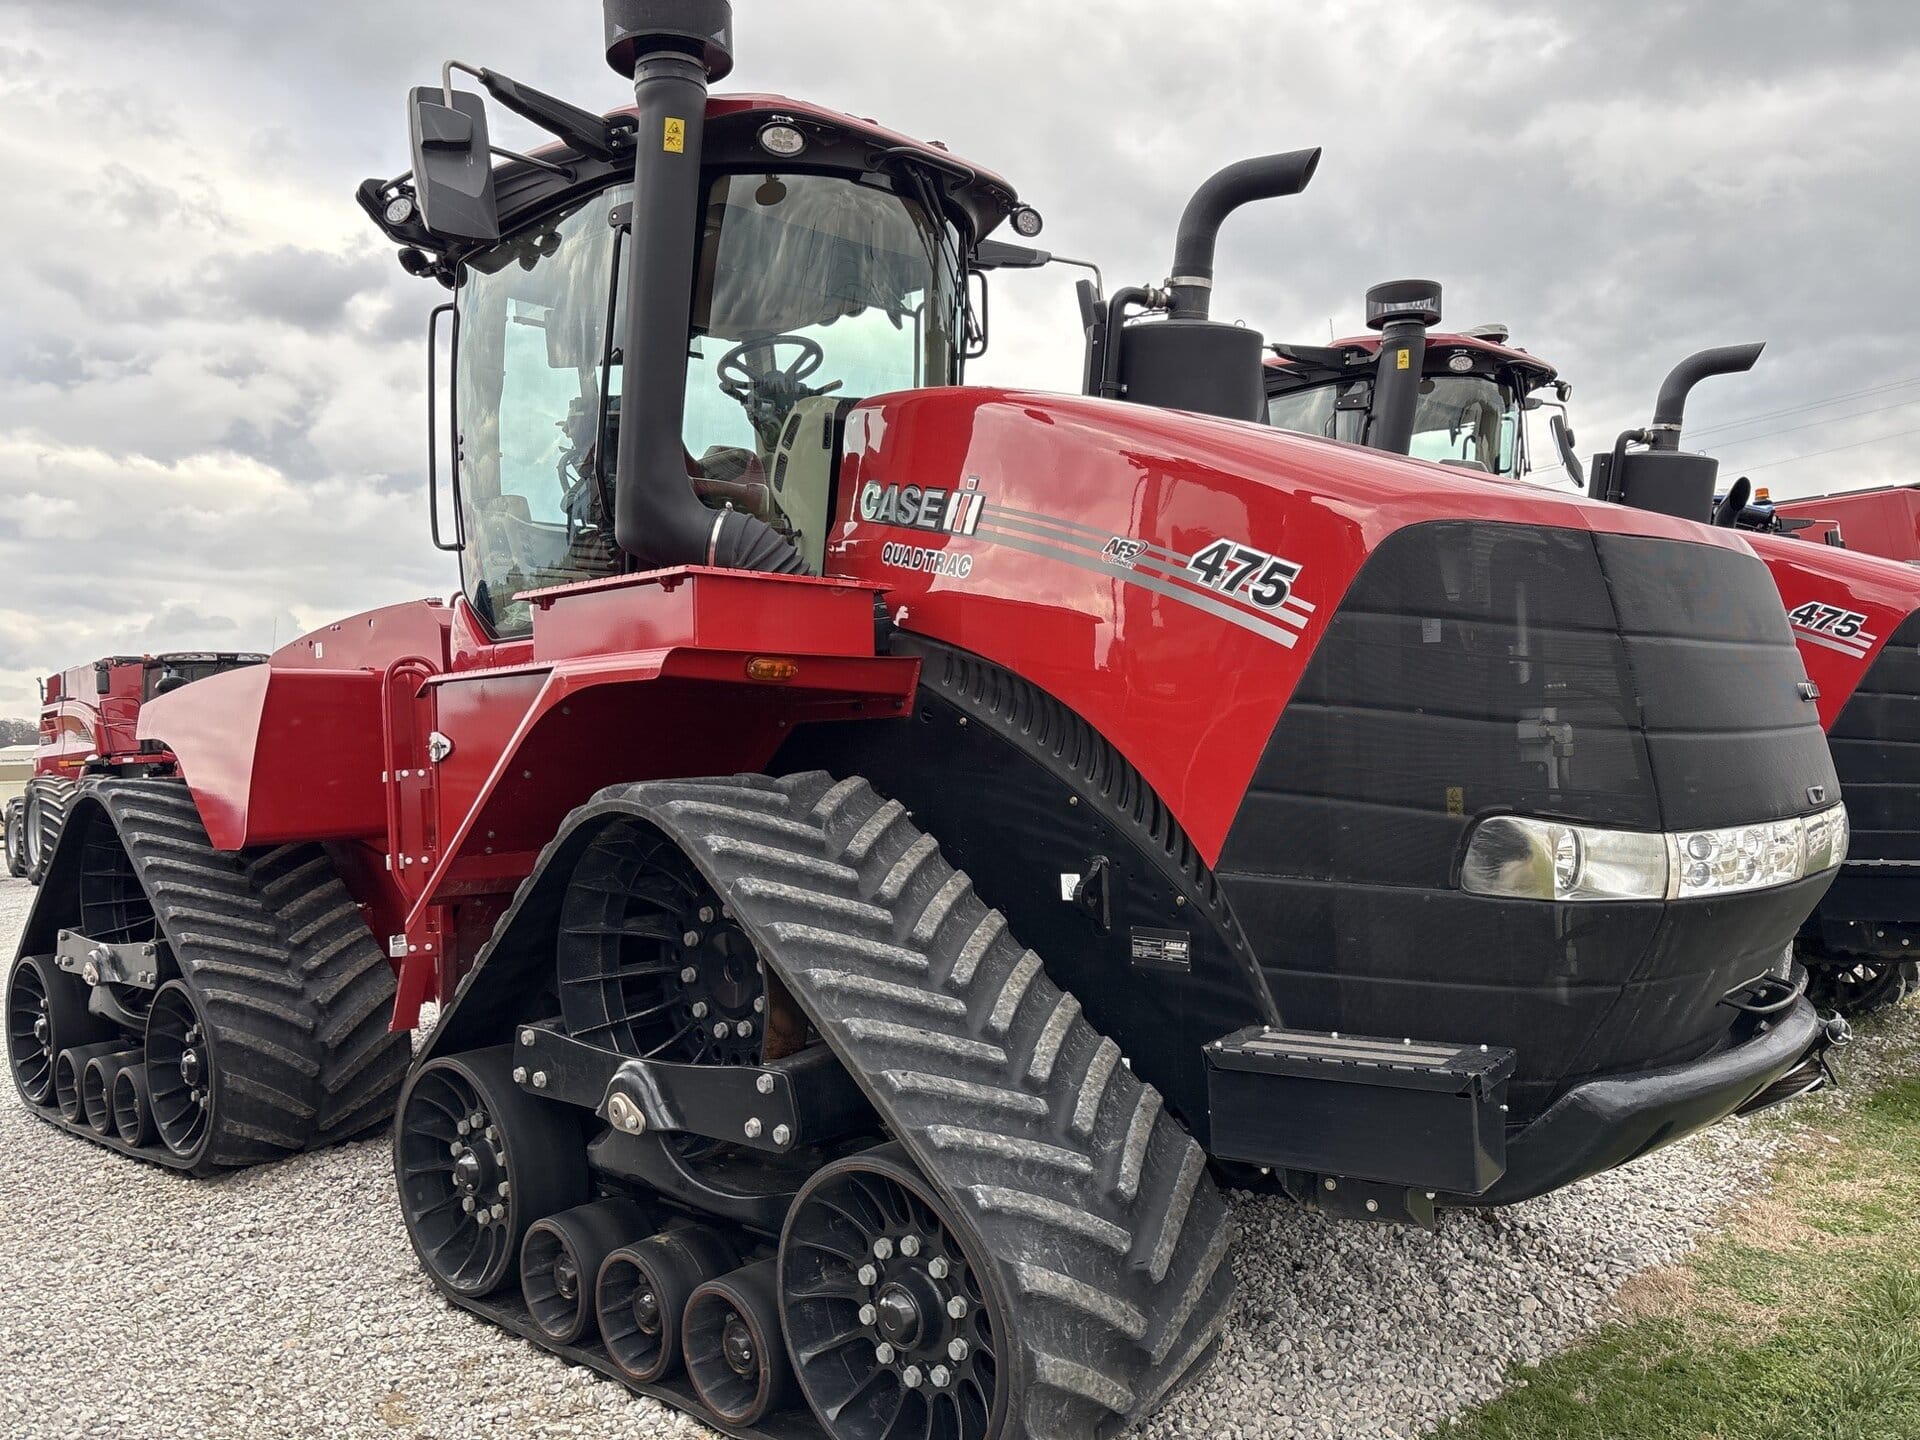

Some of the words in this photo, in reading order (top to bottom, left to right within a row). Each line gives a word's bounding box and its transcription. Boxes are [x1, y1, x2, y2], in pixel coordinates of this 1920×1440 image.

[860, 481, 947, 529] CASE
[882, 541, 973, 578] QUADTRAC
[1102, 537, 1140, 560] AFS
[1187, 538, 1303, 609] 475
[1788, 601, 1868, 638] 475
